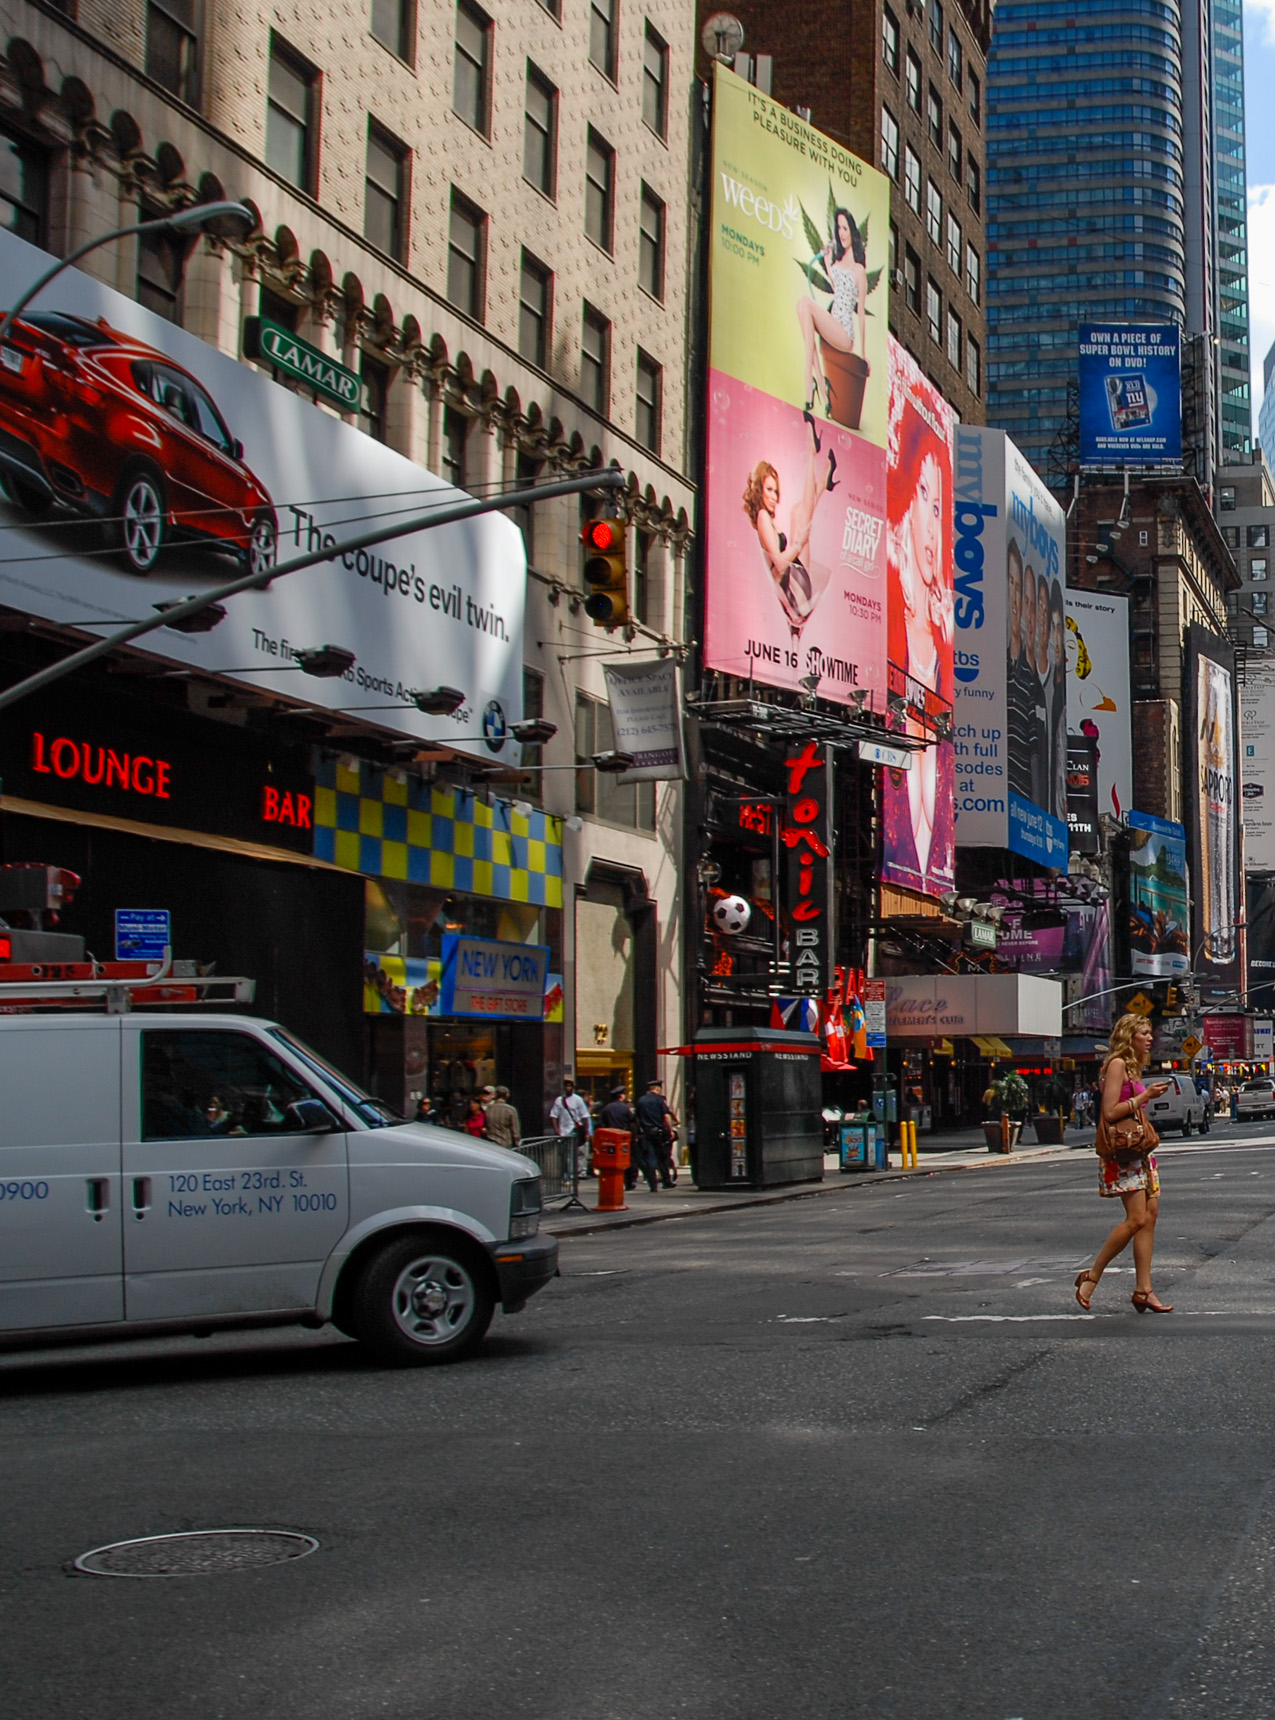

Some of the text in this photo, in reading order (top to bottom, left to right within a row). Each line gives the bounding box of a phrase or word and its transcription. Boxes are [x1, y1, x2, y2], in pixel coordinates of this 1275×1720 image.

[748, 90, 862, 176] IT'S A BUSINESS DOING
[753, 111, 858, 187] PLEASURE WITH YOU
[722, 224, 765, 256] MONDAYS
[1091, 333, 1161, 343] OWN A PIECE OF
[1080, 344, 1175, 356] SUPER BOWL HISTORY
[270, 335, 352, 399] LAMAR
[1109, 357, 1146, 367] ON DVD!
[845, 506, 884, 539] SECRET
[842, 527, 880, 561] DIARY
[340, 548, 425, 603] coupe's
[429, 584, 461, 620] evil
[466, 595, 509, 642] twin.
[844, 590, 881, 612] MONDAYS
[850, 605, 882, 624] 10:30 PM
[1075, 601, 1116, 614] their story
[252, 628, 394, 696] The Sports
[744, 639, 798, 668] JUNE 16
[806, 647, 858, 686] SHOWTIME
[964, 687, 995, 700] funny
[954, 726, 1001, 741] tch up
[954, 743, 998, 757] th full
[955, 761, 1003, 776] sodes
[32, 732, 311, 829] LOUNGE BAR
[960, 780, 975, 792] at
[953, 798, 1005, 812] s.com
[974, 927, 994, 942] LAMAR
[461, 951, 540, 983] NEW YORK
[796, 929, 819, 986] BAR
[470, 996, 527, 1012] THE GIFT STORE
[698, 1052, 752, 1060] NEWSSTAND
[169, 1172, 307, 1192] 120 East 23rd. St.
[168, 1193, 337, 1217] New York, NY 10010
